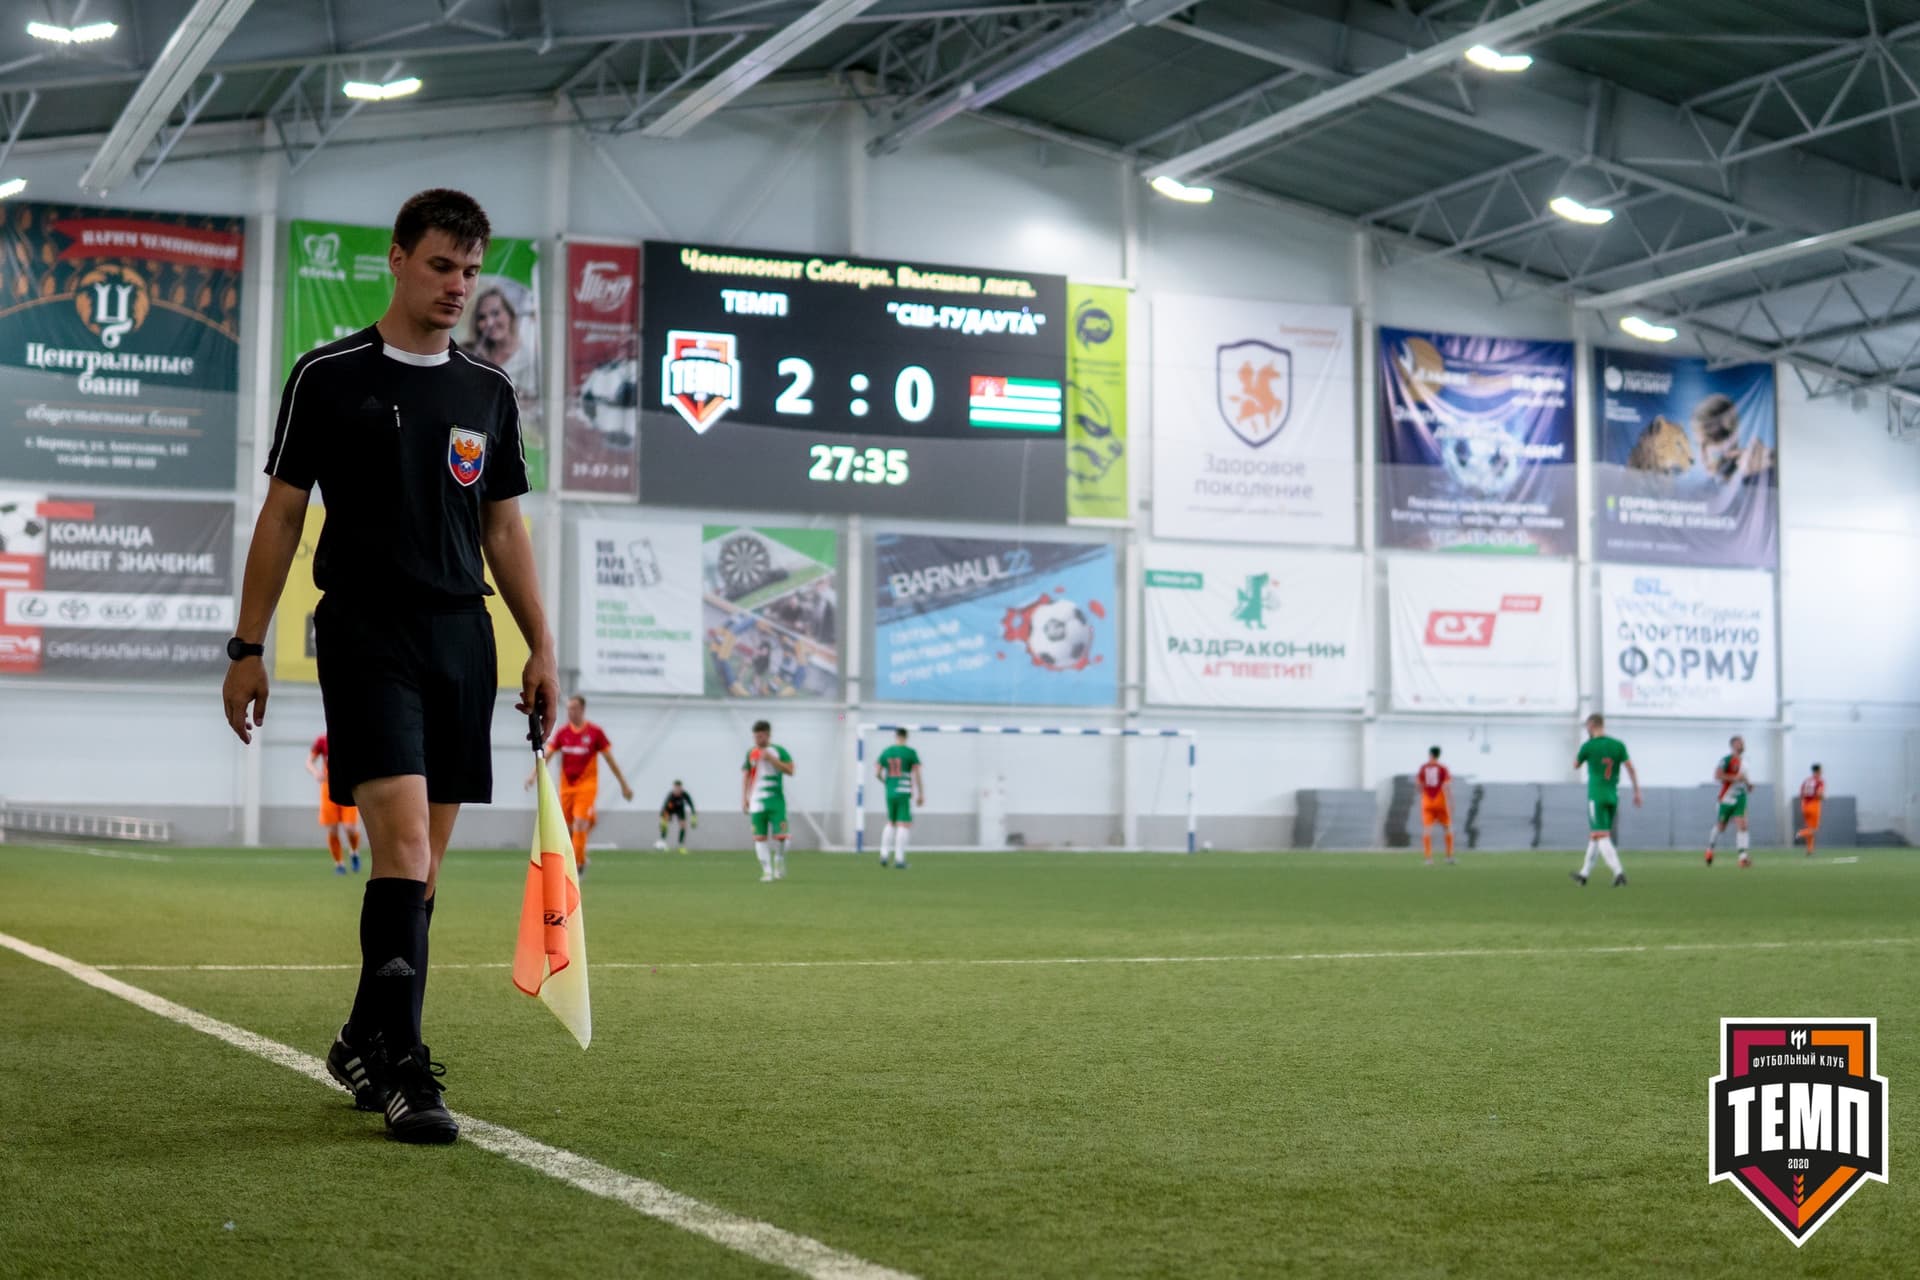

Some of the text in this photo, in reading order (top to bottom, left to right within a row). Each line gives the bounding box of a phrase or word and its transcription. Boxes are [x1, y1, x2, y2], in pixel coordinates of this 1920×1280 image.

[681, 248, 1037, 298] Чемпионат Сибири. Высшая лига.
[720, 289, 789, 316] ТЕМП
[26, 342, 194, 375] Центральные
[78, 373, 139, 396] бани
[775, 358, 814, 415] 2
[894, 365, 934, 422] 0
[808, 445, 909, 485] 27:35
[1203, 454, 1306, 477] Здоровое
[1194, 479, 1315, 499] поколение
[50, 521, 153, 548] КОМАНДА
[50, 549, 215, 575] ИМЕЕТ ЗНАЧЕНИЕ
[1618, 644, 1758, 681] ФОРМУ
[1602, 757, 1613, 780] 7
